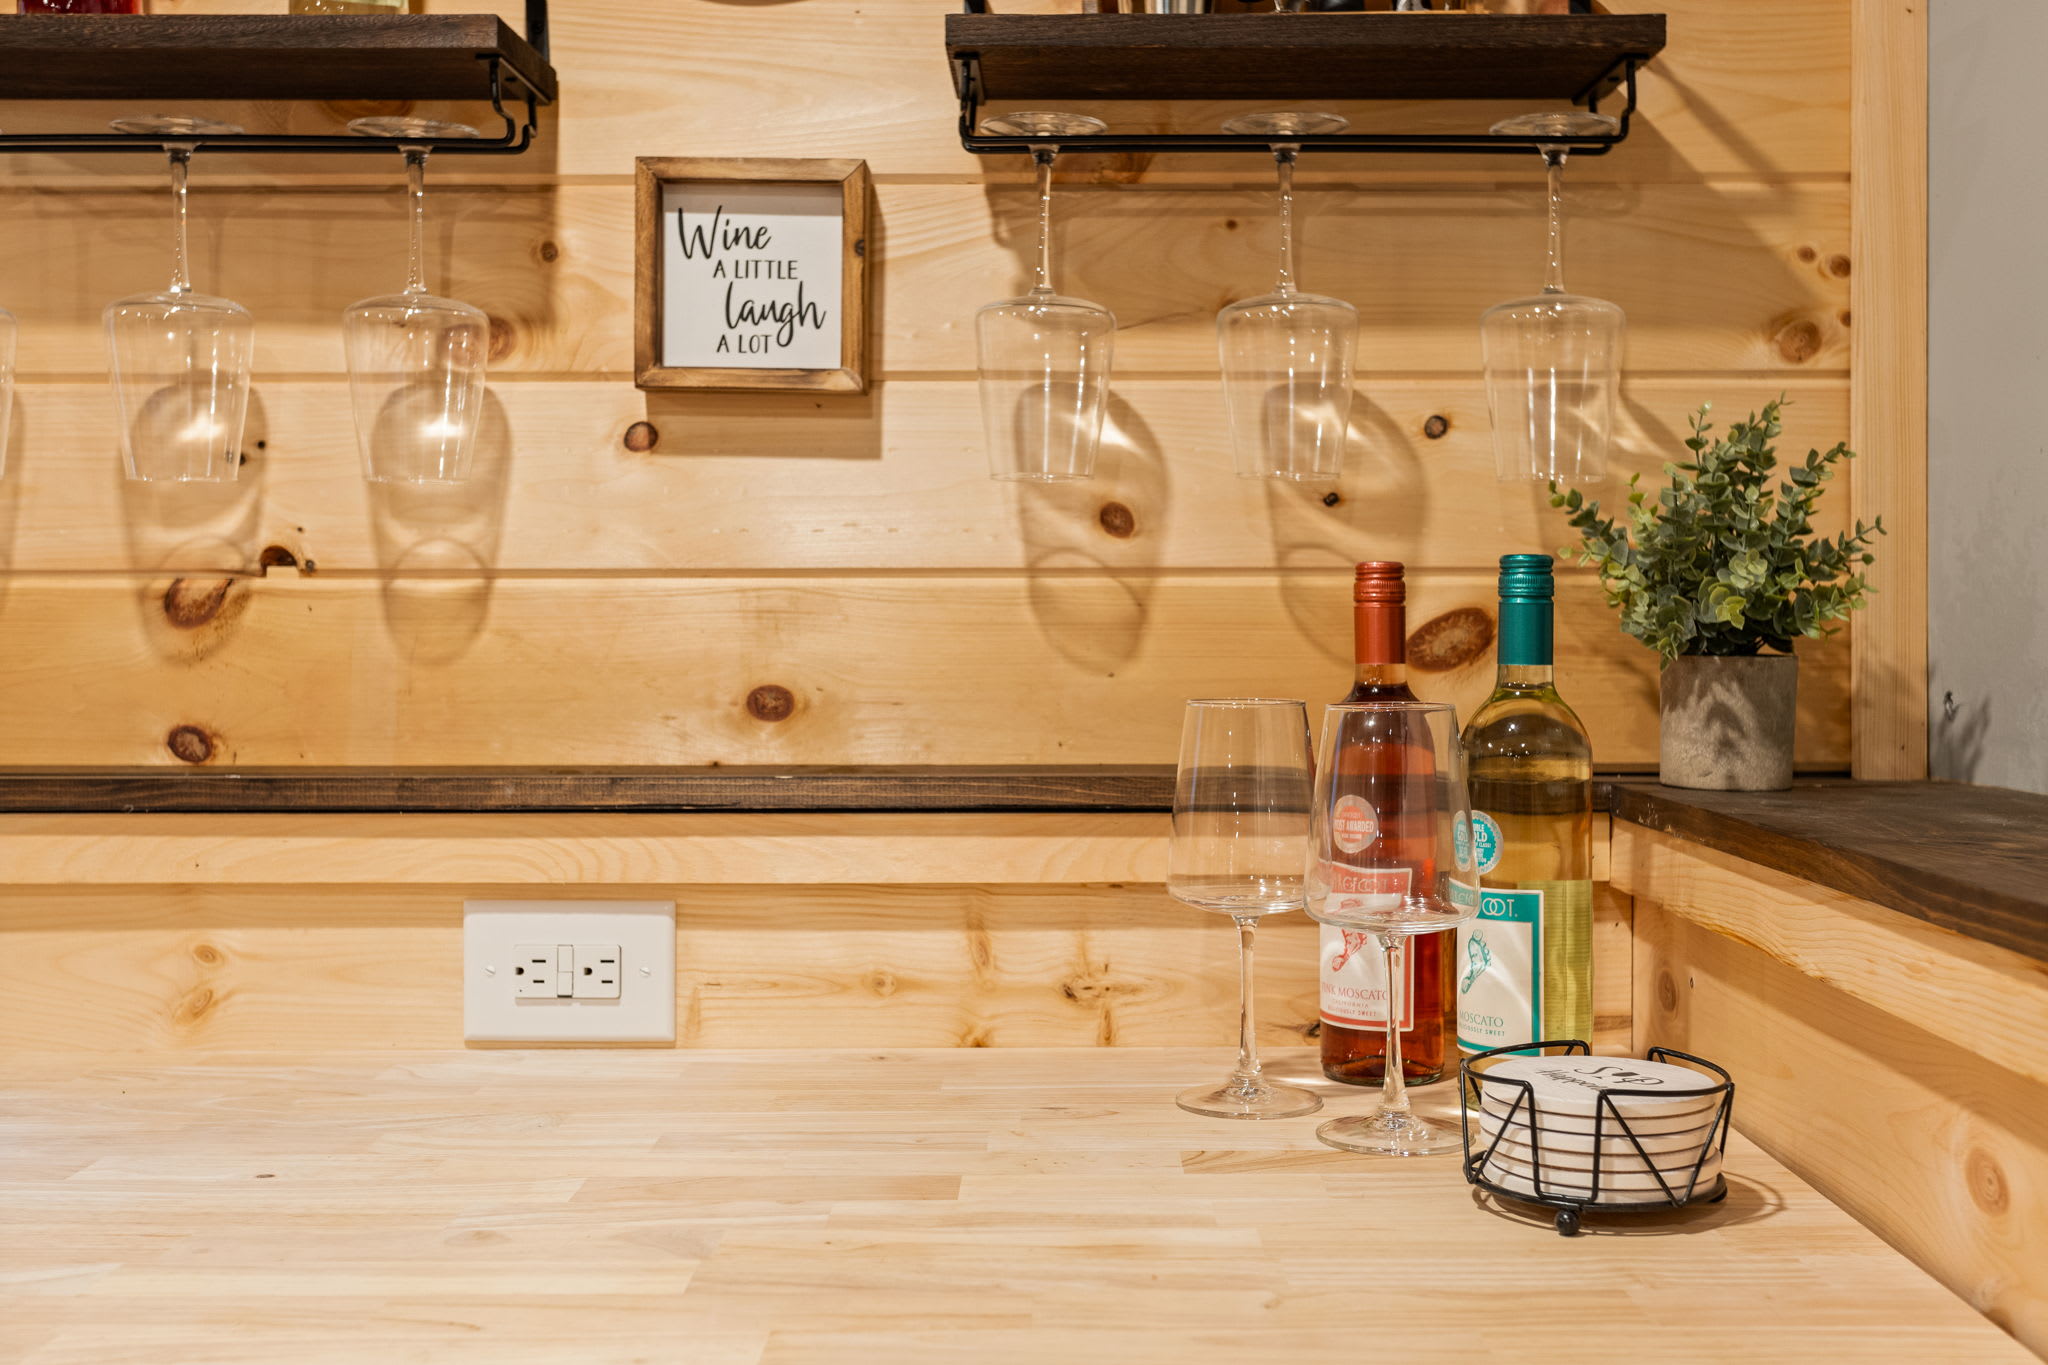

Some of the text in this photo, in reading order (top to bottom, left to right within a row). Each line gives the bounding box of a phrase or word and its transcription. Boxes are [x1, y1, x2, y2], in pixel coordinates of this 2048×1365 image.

[678, 205, 771, 259] Wine
[713, 259, 799, 280] A LITTLE
[716, 334, 772, 354] A LOT
